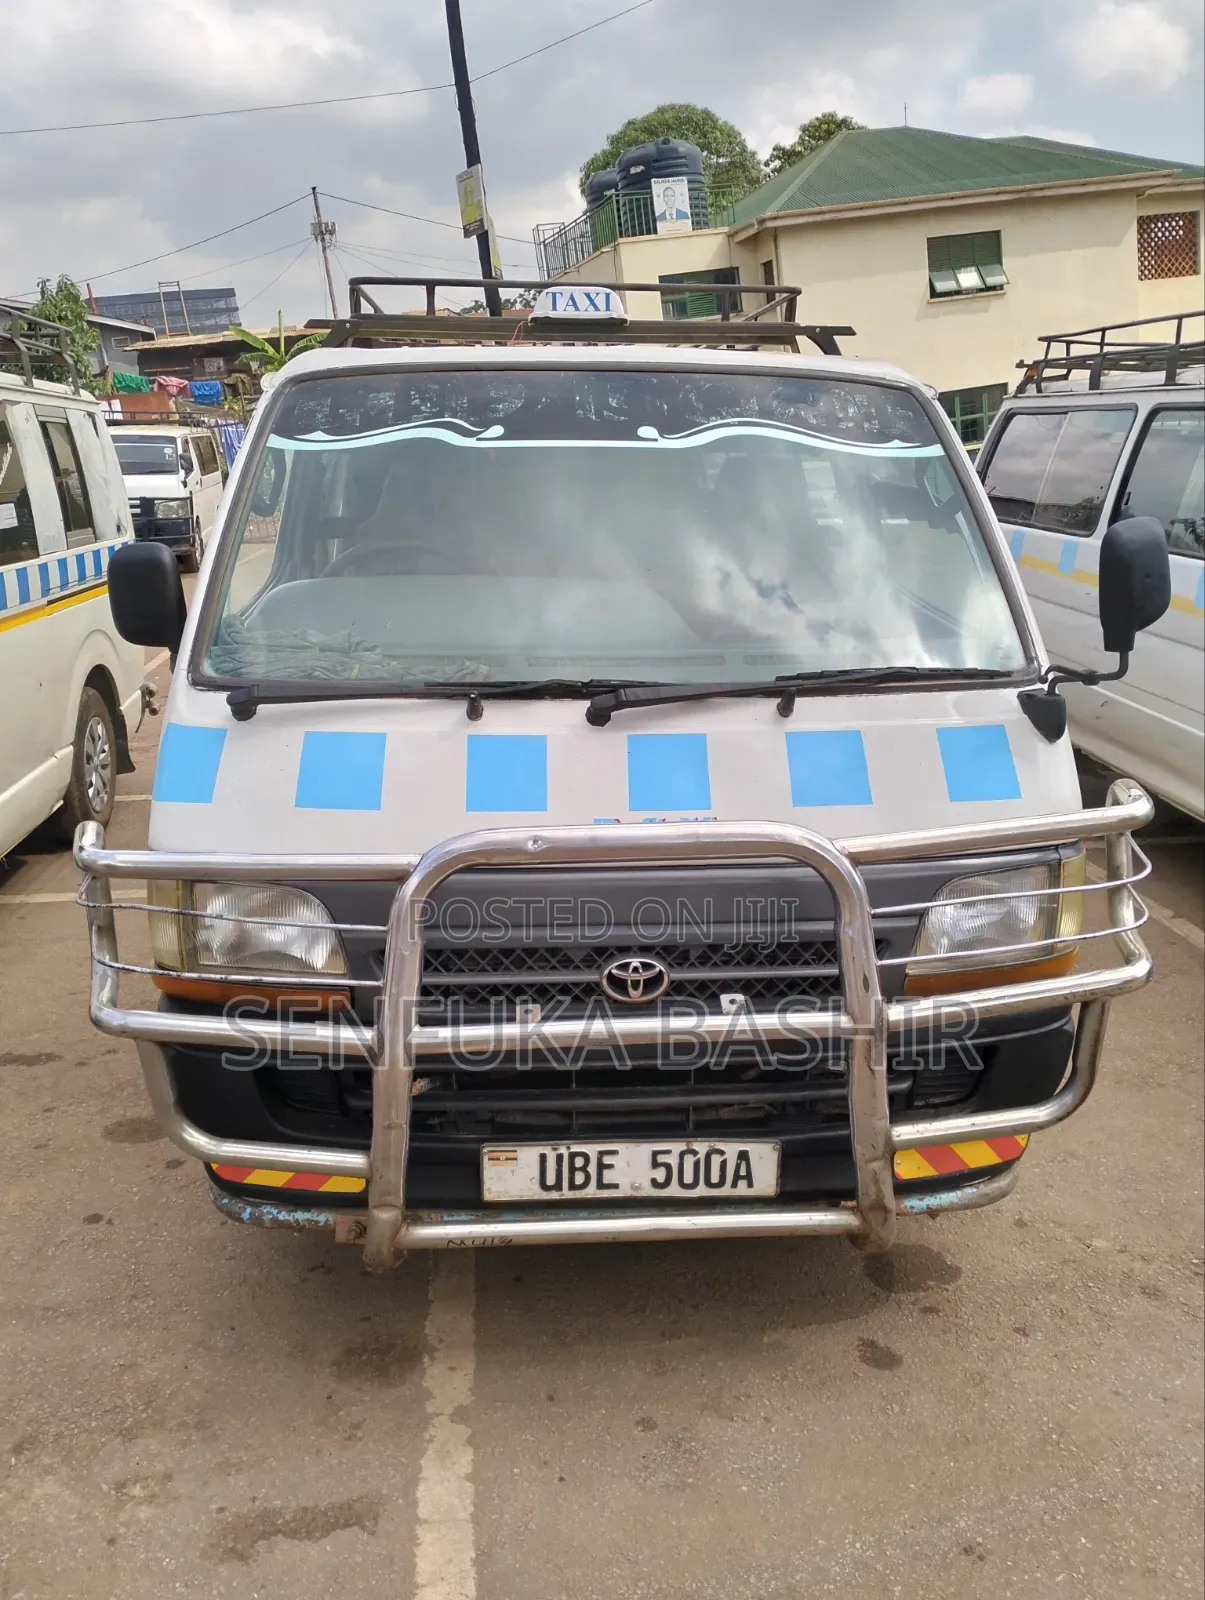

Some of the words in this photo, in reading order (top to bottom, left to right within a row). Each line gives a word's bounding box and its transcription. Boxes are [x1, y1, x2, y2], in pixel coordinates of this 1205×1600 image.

[546, 291, 613, 312] TAXI
[538, 1149, 620, 1192] UBE
[650, 1149, 755, 1191] 500A
